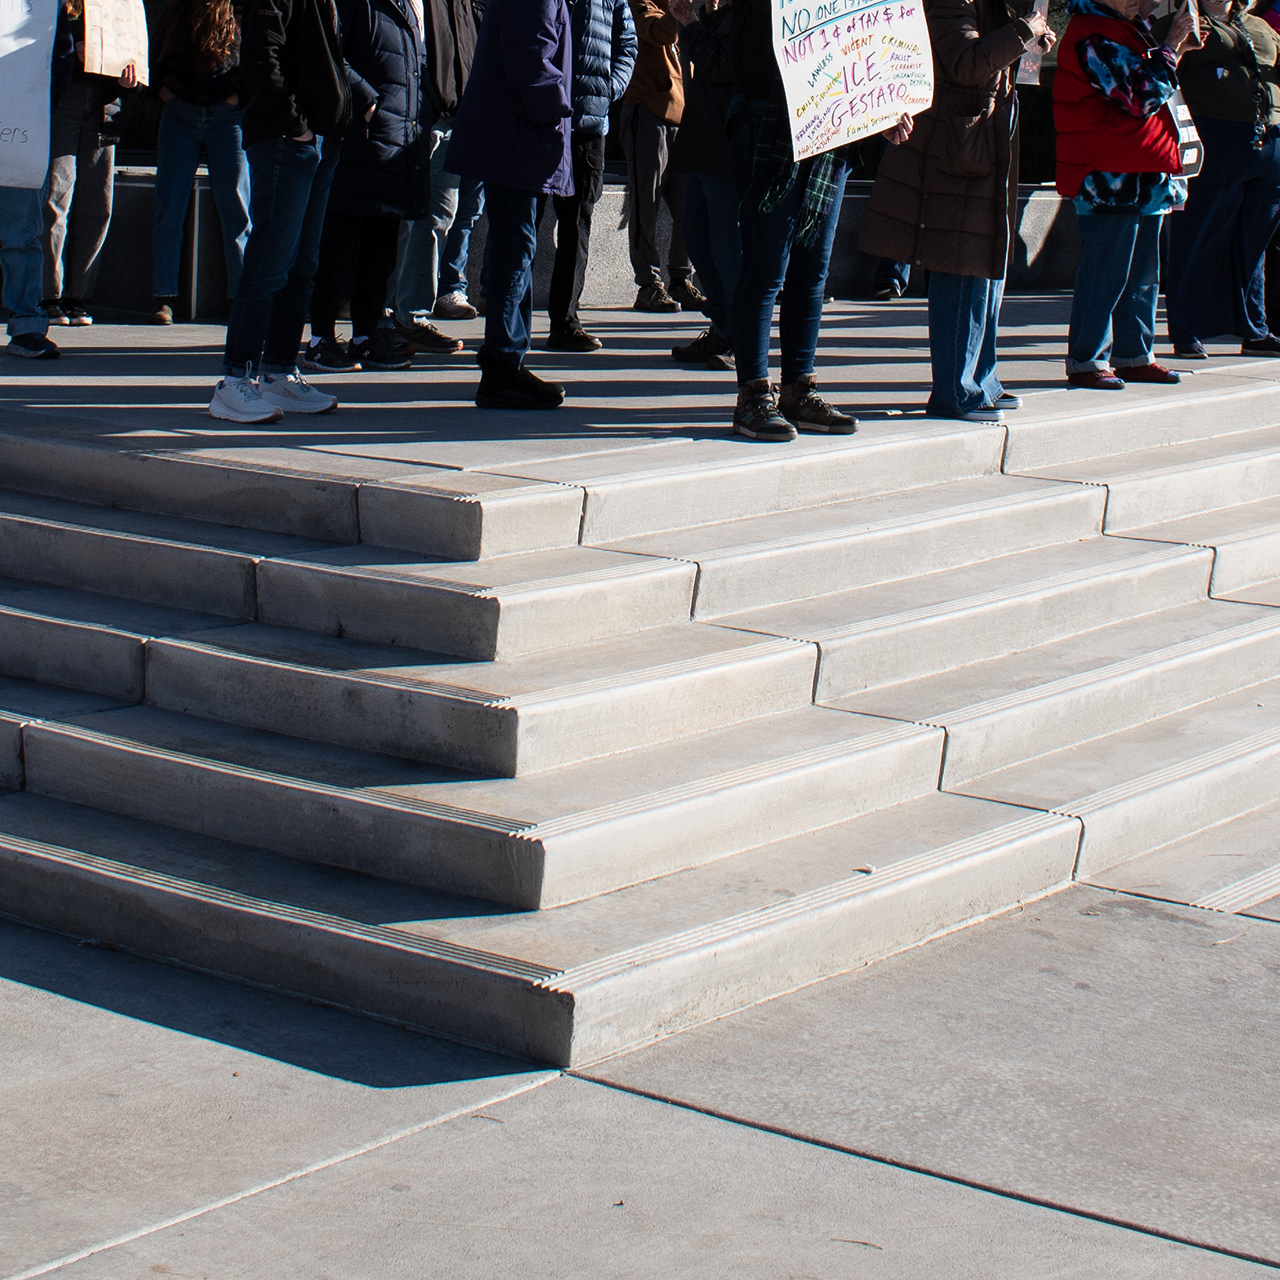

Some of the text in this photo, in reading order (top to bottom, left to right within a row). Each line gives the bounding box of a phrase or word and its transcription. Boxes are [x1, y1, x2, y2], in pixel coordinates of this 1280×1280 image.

[782, 7, 810, 39] NO
[782, 31, 815, 67] NOT
[858, 9, 879, 32] TAX
[831, 82, 908, 128] GESTAPO
